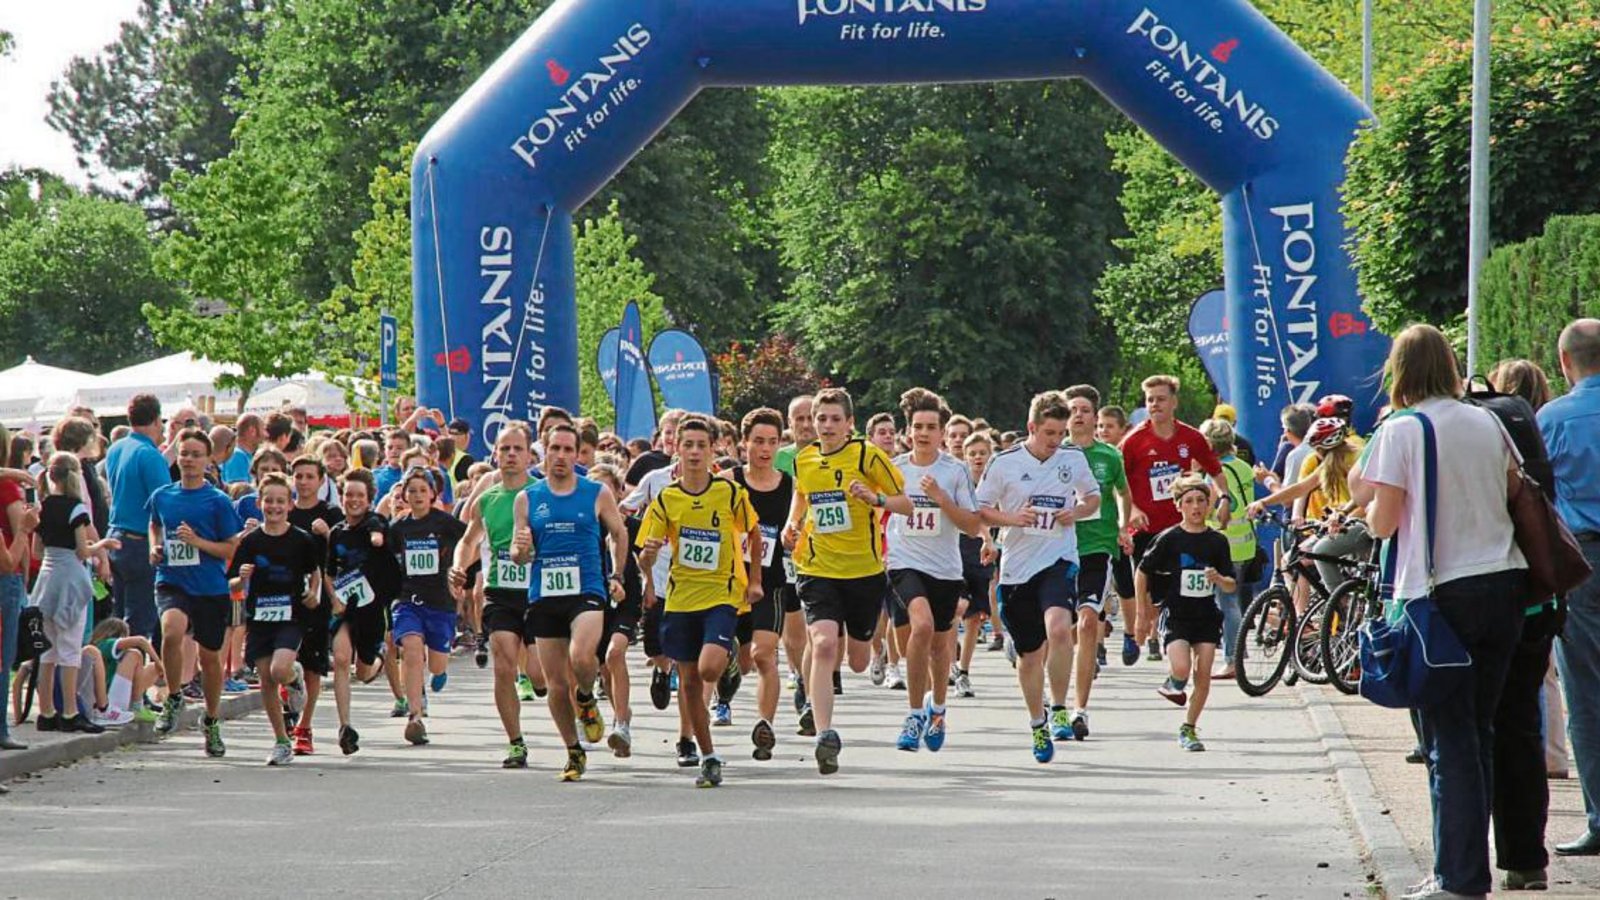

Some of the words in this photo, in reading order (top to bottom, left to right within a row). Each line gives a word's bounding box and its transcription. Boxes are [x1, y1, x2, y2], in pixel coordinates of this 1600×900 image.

[840, 24, 866, 40] Fit
[872, 23, 901, 39] for
[907, 22, 946, 38] life.
[1126, 7, 1280, 139] FONTANIS
[510, 22, 651, 168] FONTANIS
[1145, 60, 1171, 83] Fit
[1168, 80, 1196, 105] for
[1193, 102, 1223, 133] life.
[563, 126, 588, 151] Fit
[585, 102, 610, 129] for
[608, 77, 642, 106] life.
[1252, 264, 1272, 298] Fit
[525, 282, 545, 333] life.
[384, 323, 395, 365] P
[480, 226, 512, 455] ONTANIS
[1254, 307, 1273, 347] for
[526, 340, 546, 381] for
[1256, 355, 1277, 407] life.
[835, 469, 843, 488] 9
[711, 510, 720, 528] 6
[816, 506, 845, 527] 259
[906, 511, 935, 530] 414
[169, 543, 194, 560] 320
[410, 553, 434, 569] 400
[684, 543, 713, 563] 282
[501, 564, 526, 582] 269
[546, 571, 573, 590] 301
